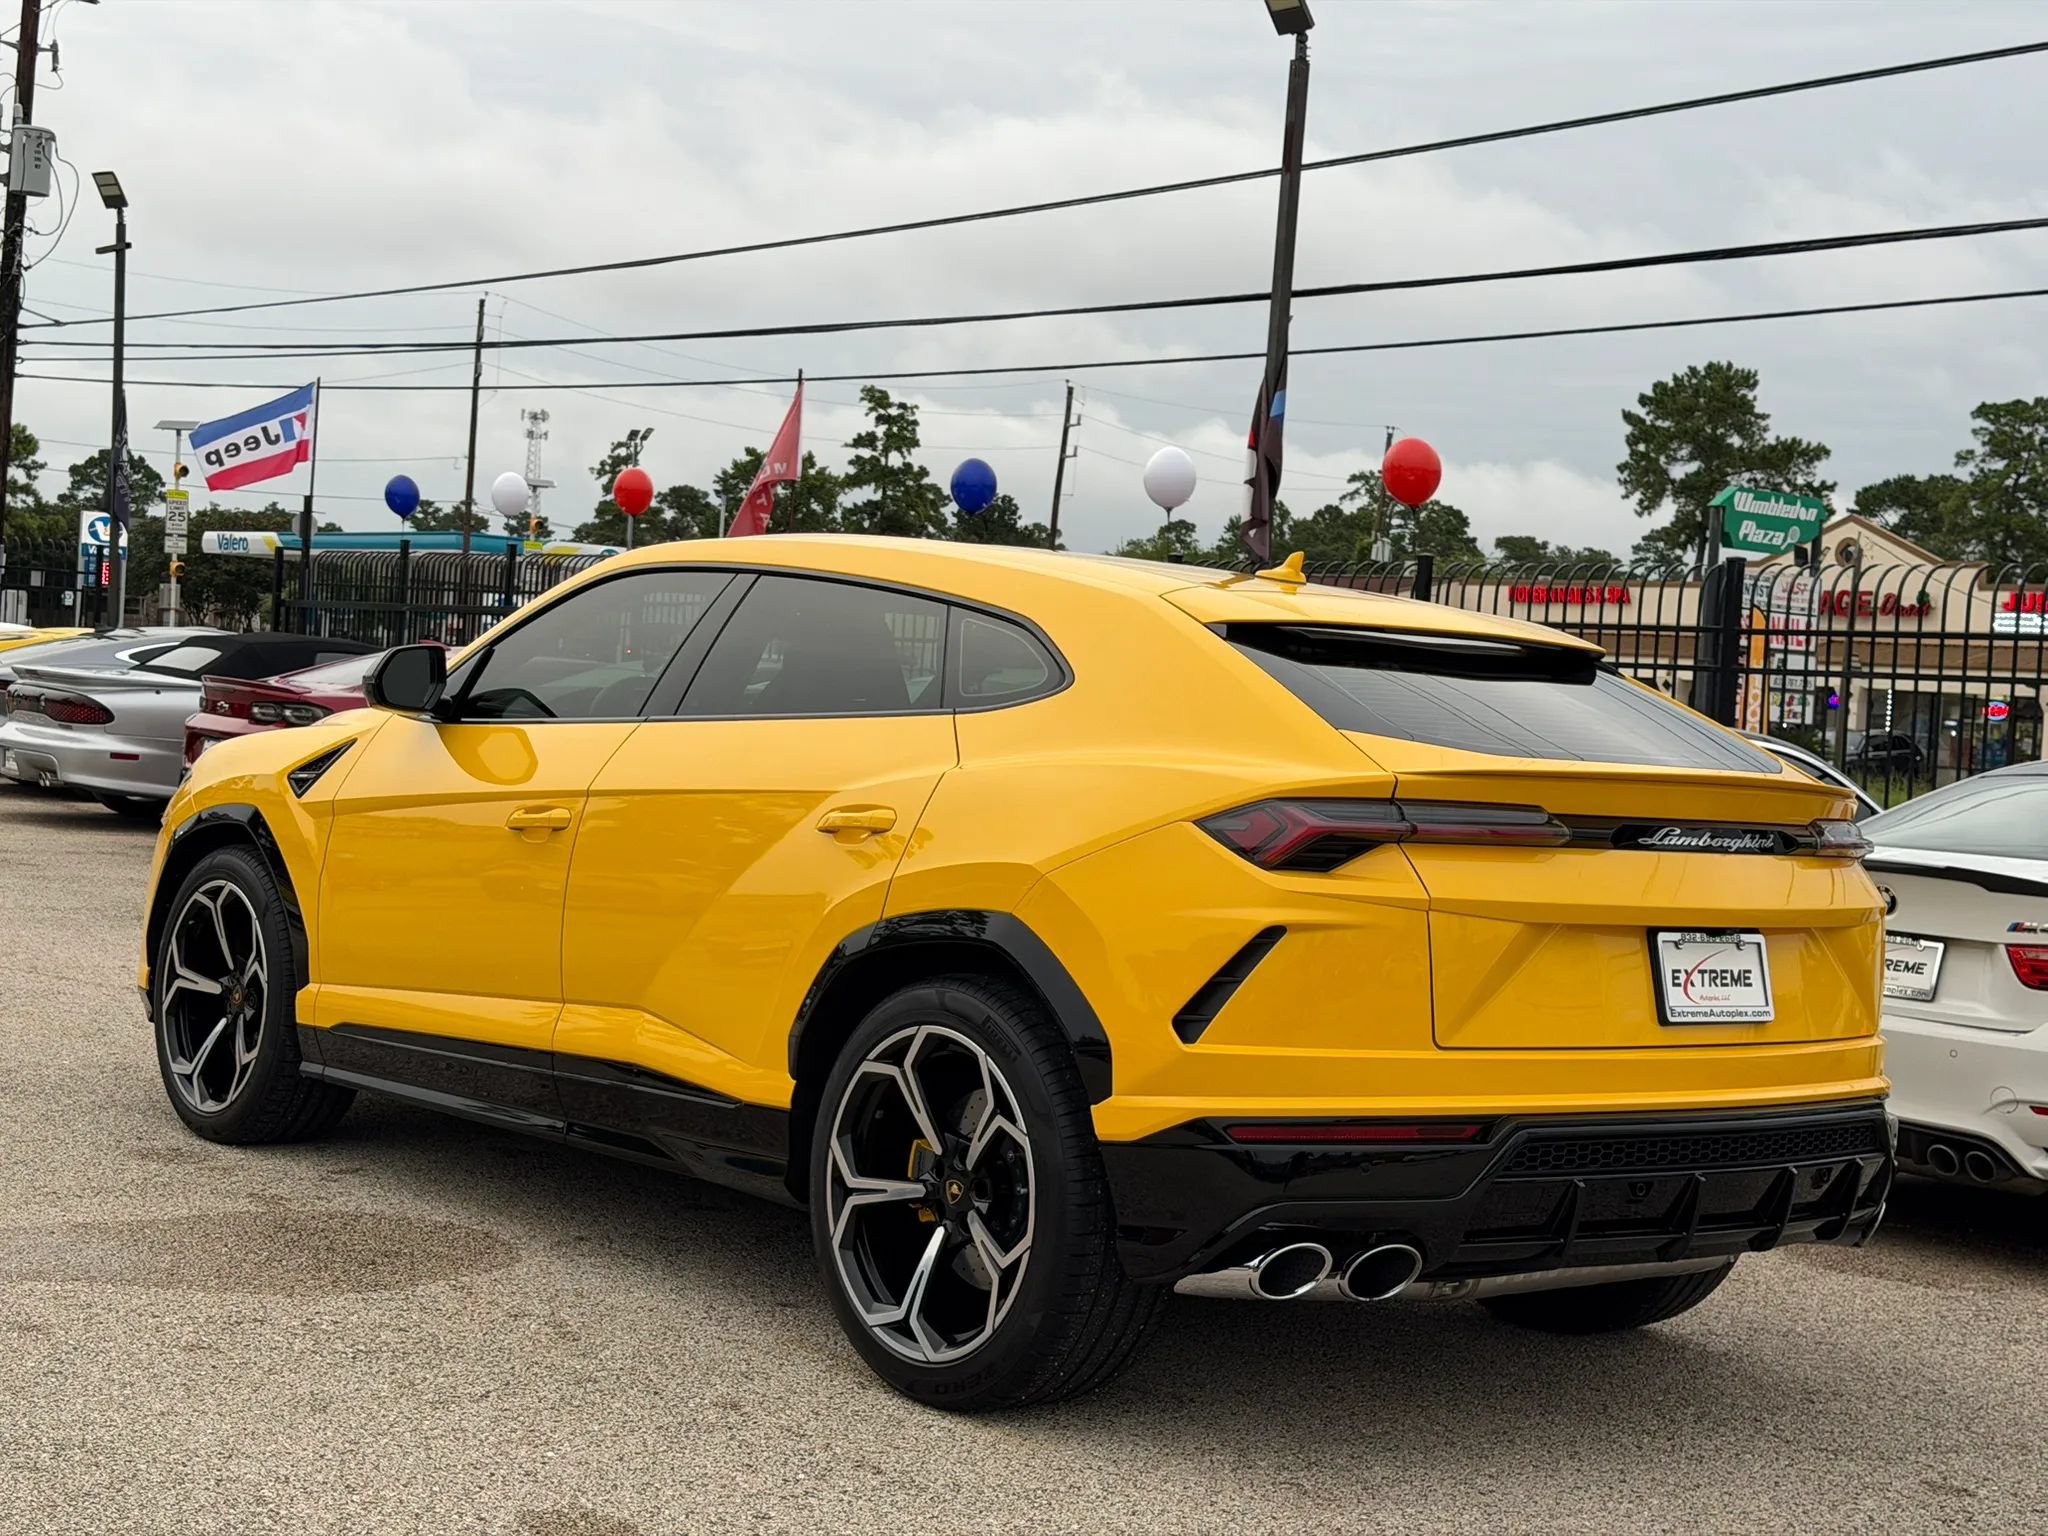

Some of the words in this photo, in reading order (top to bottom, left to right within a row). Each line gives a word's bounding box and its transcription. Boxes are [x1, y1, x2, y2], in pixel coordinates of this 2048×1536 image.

[1733, 491, 1819, 522] Wimbledon
[168, 511, 186, 522] 25
[217, 533, 249, 551] Valero
[1739, 520, 1785, 545] Plaza
[1638, 827, 1774, 852] Lamborghini
[1671, 969, 1753, 988] EXTREME
[1670, 1008, 1771, 1018] ExtremeAutoplex.com
